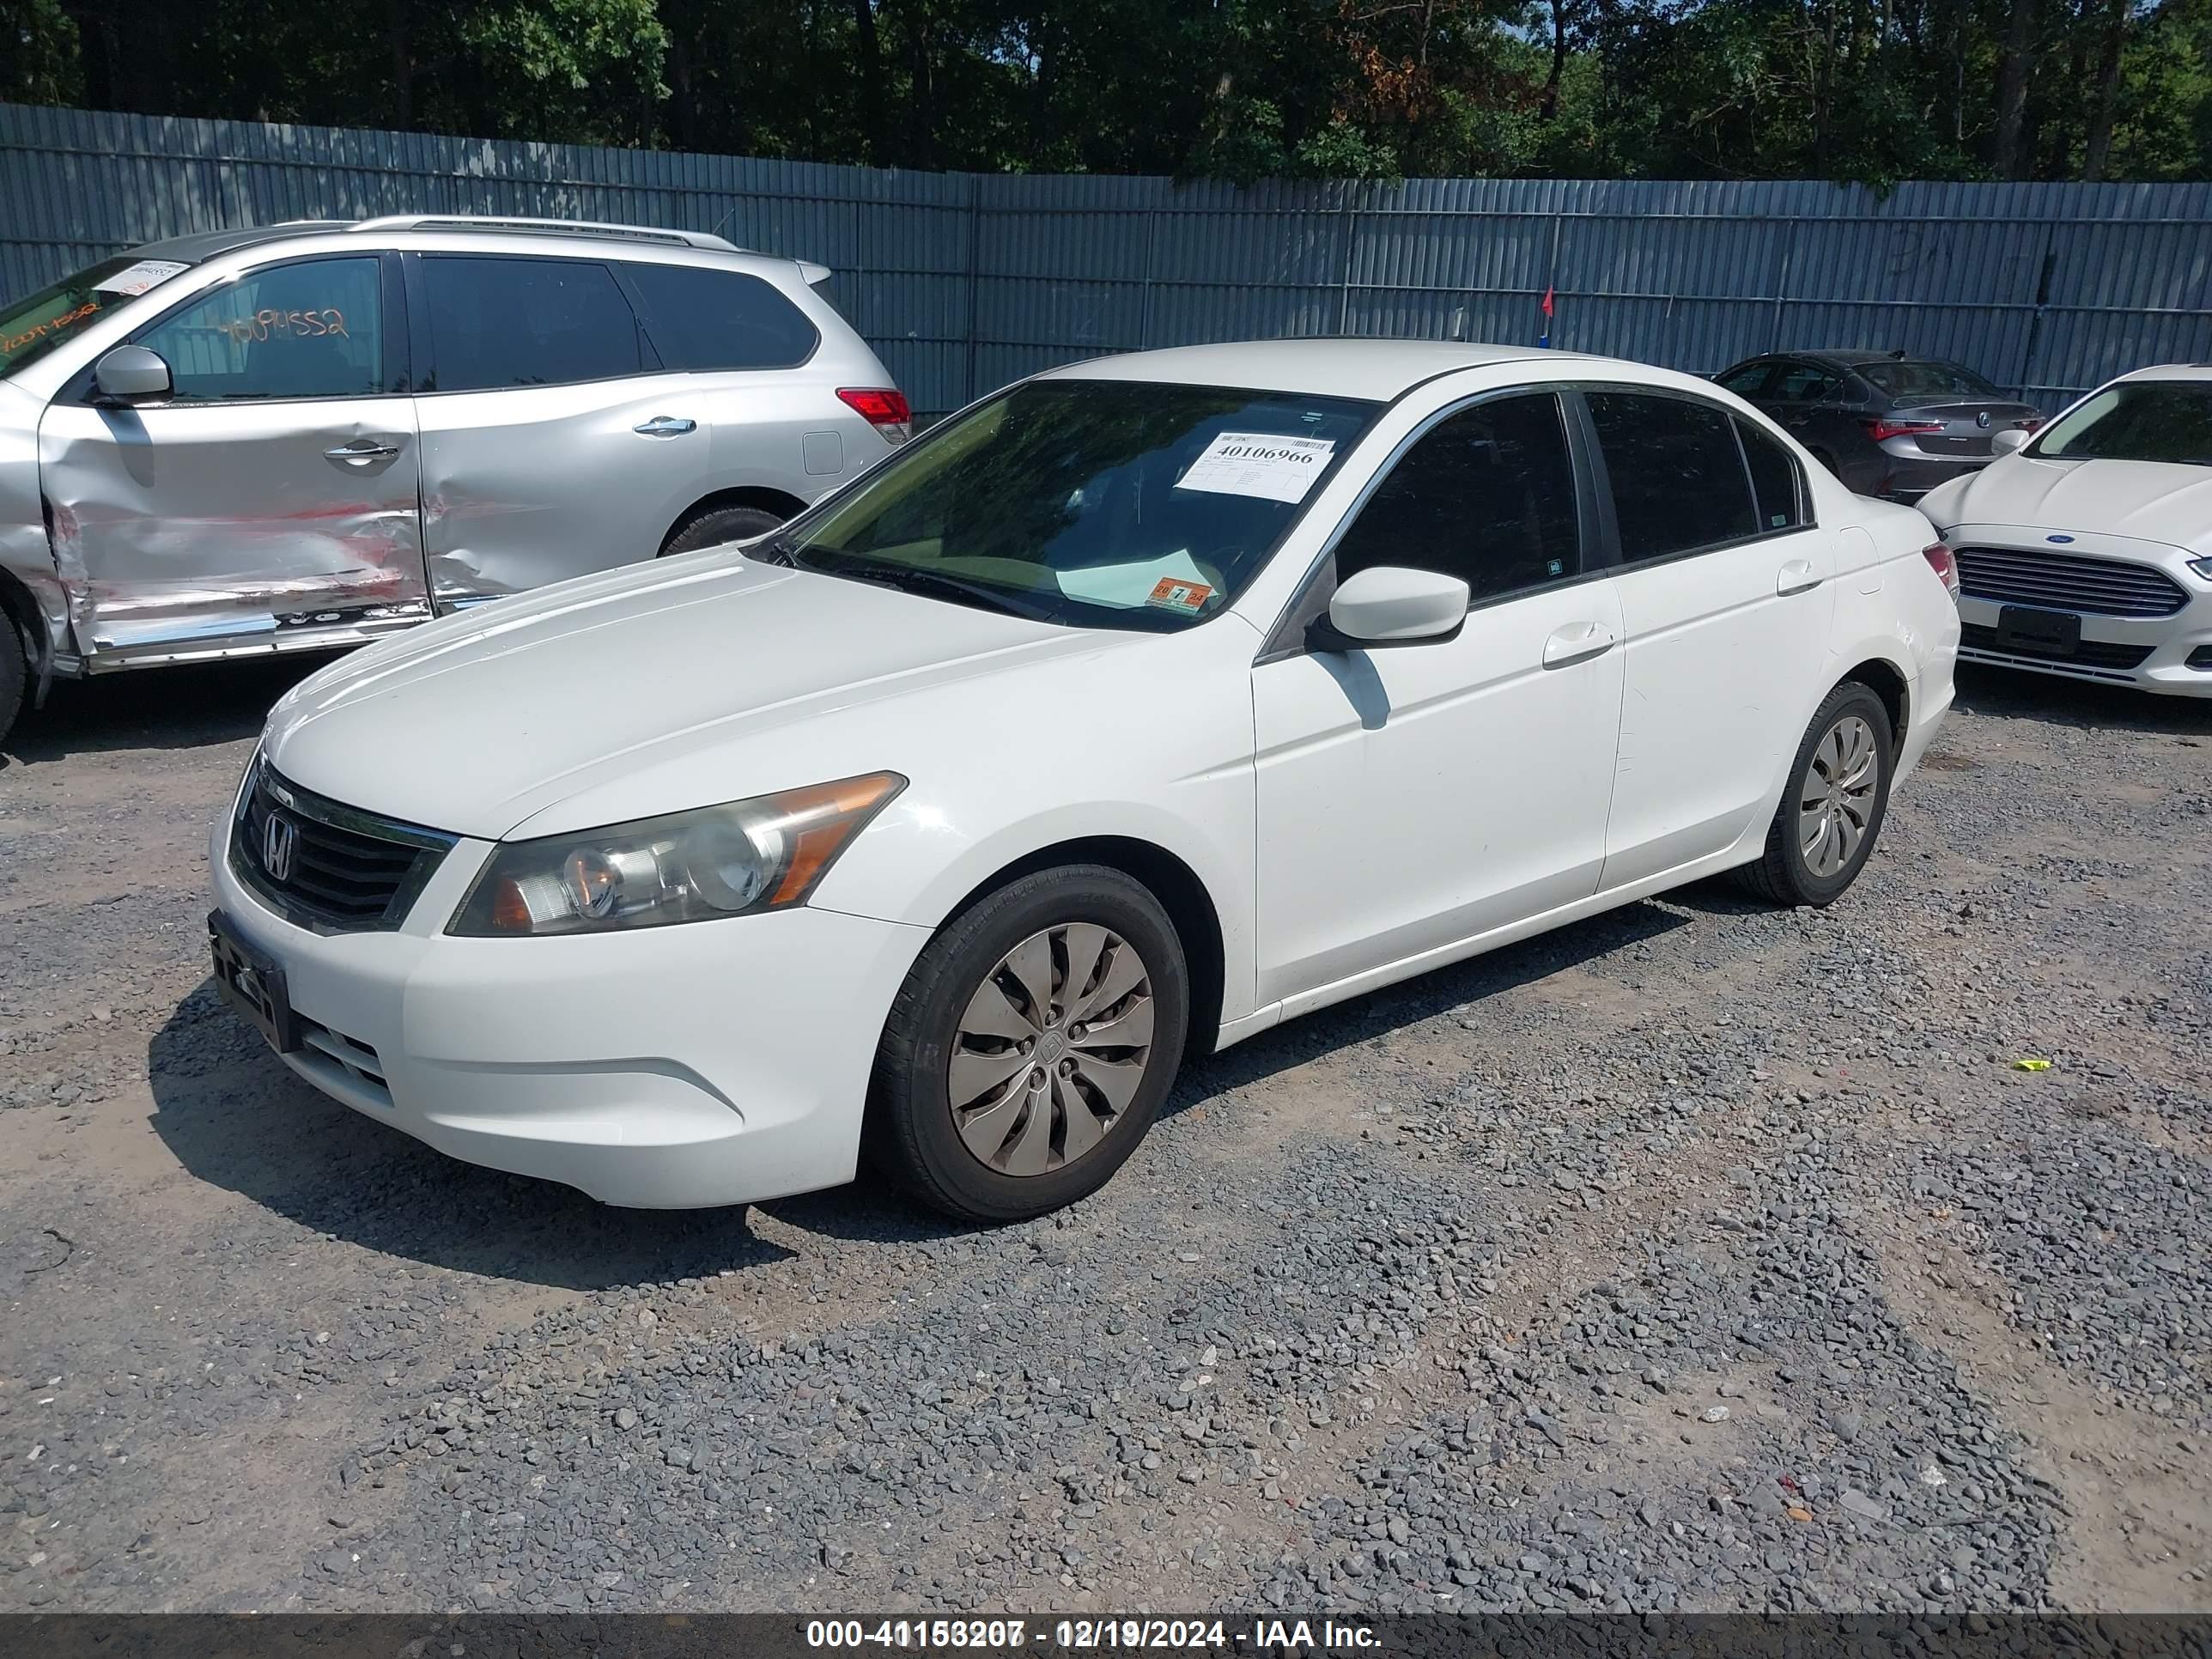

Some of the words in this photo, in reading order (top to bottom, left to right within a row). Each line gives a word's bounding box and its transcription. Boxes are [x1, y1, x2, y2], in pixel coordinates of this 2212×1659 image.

[1218, 445, 1317, 465] 40106966
[1174, 588, 1185, 599] 7
[1190, 592, 1203, 602] 24
